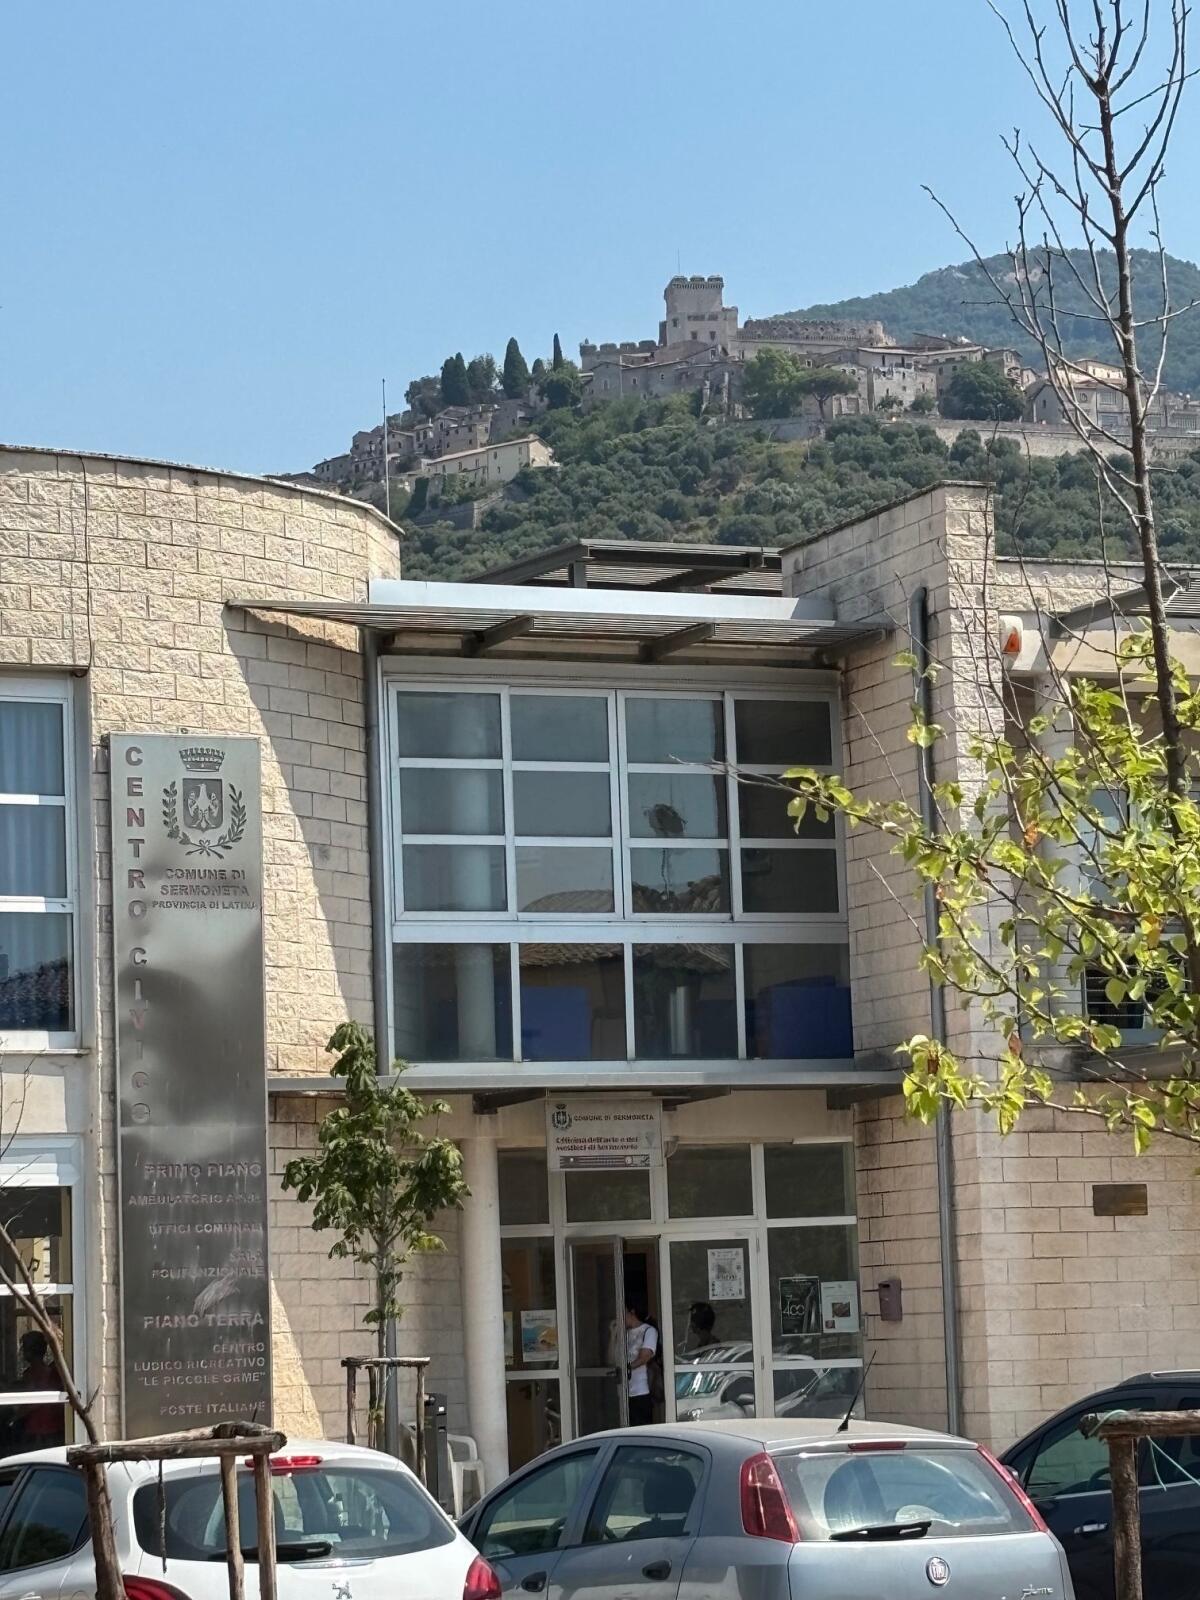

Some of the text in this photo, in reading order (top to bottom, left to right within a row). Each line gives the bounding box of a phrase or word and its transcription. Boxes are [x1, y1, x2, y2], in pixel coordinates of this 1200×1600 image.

[125, 746, 147, 919] CENTRO
[165, 868, 246, 881] COMUNE DI
[160, 884, 250, 897] SERMONETA
[152, 900, 258, 910] PROVINCIA DI LATINA
[144, 1162, 262, 1179] PRIMO PIANO
[149, 1222, 264, 1235] UFFICI COMUNALI
[144, 1312, 264, 1329] PIANO TERRA
[213, 1342, 265, 1353] CENTRO
[134, 1356, 265, 1372] LUDICO RICREATIVO
[163, 1374, 220, 1386] PICCOLE
[159, 1401, 265, 1416] POSTE ITALIANE
